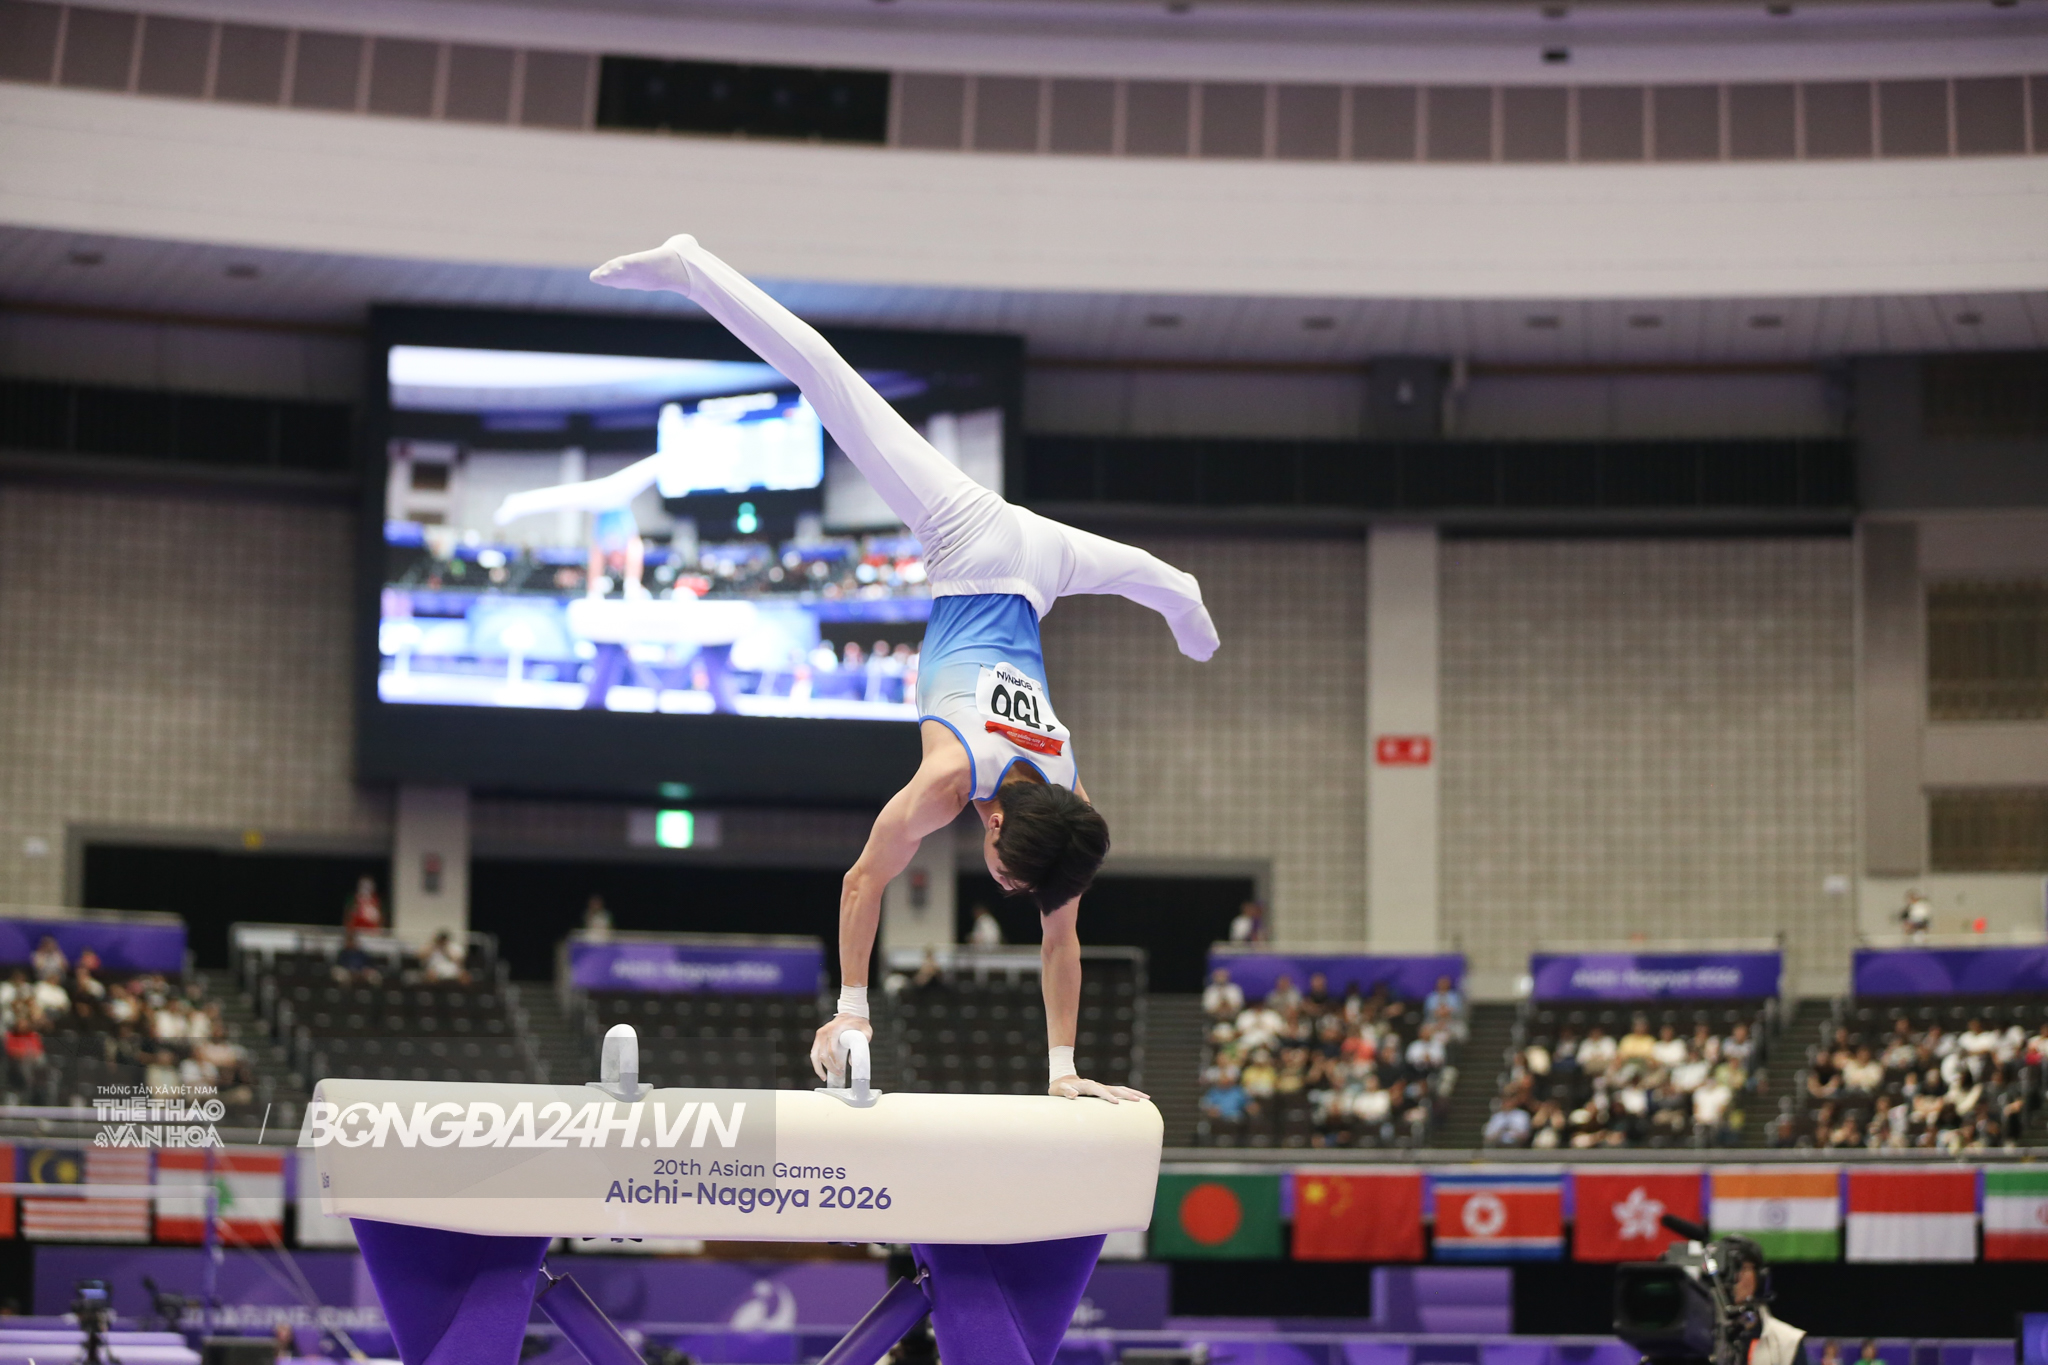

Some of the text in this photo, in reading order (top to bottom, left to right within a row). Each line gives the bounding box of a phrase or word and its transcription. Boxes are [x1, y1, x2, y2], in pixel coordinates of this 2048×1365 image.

[653, 1158, 847, 1180] 20th Asian Games
[605, 1178, 892, 1214] Aichi-Nagoya 2026
